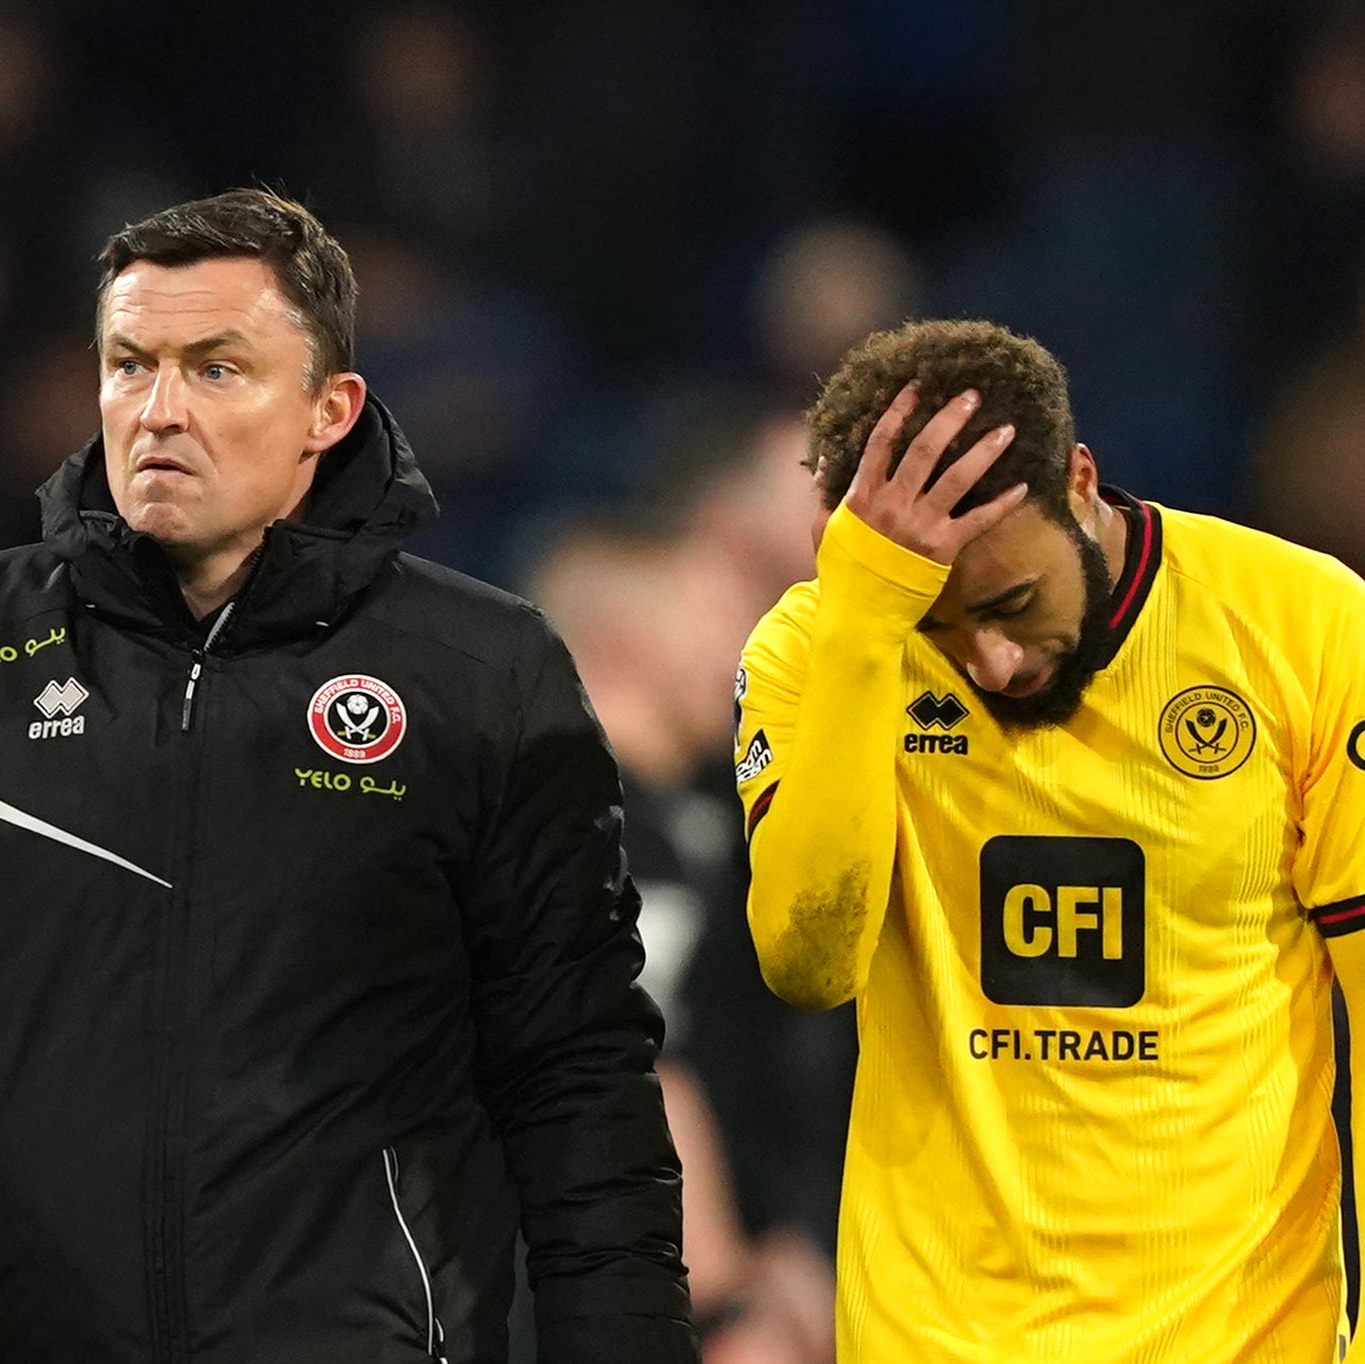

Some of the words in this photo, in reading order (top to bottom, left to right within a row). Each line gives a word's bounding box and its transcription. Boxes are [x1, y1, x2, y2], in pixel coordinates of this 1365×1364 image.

[314, 679, 358, 714] SHEFFIELD
[360, 679, 395, 705] UNITED
[1165, 692, 1202, 733] SHEFFIELD
[1205, 691, 1240, 712] UNITED
[28, 715, 85, 739] errea
[904, 733, 969, 755] errea
[294, 768, 351, 791] YELO
[1003, 883, 1123, 960] CFI
[969, 1029, 1159, 1060] CFI.TRADE
